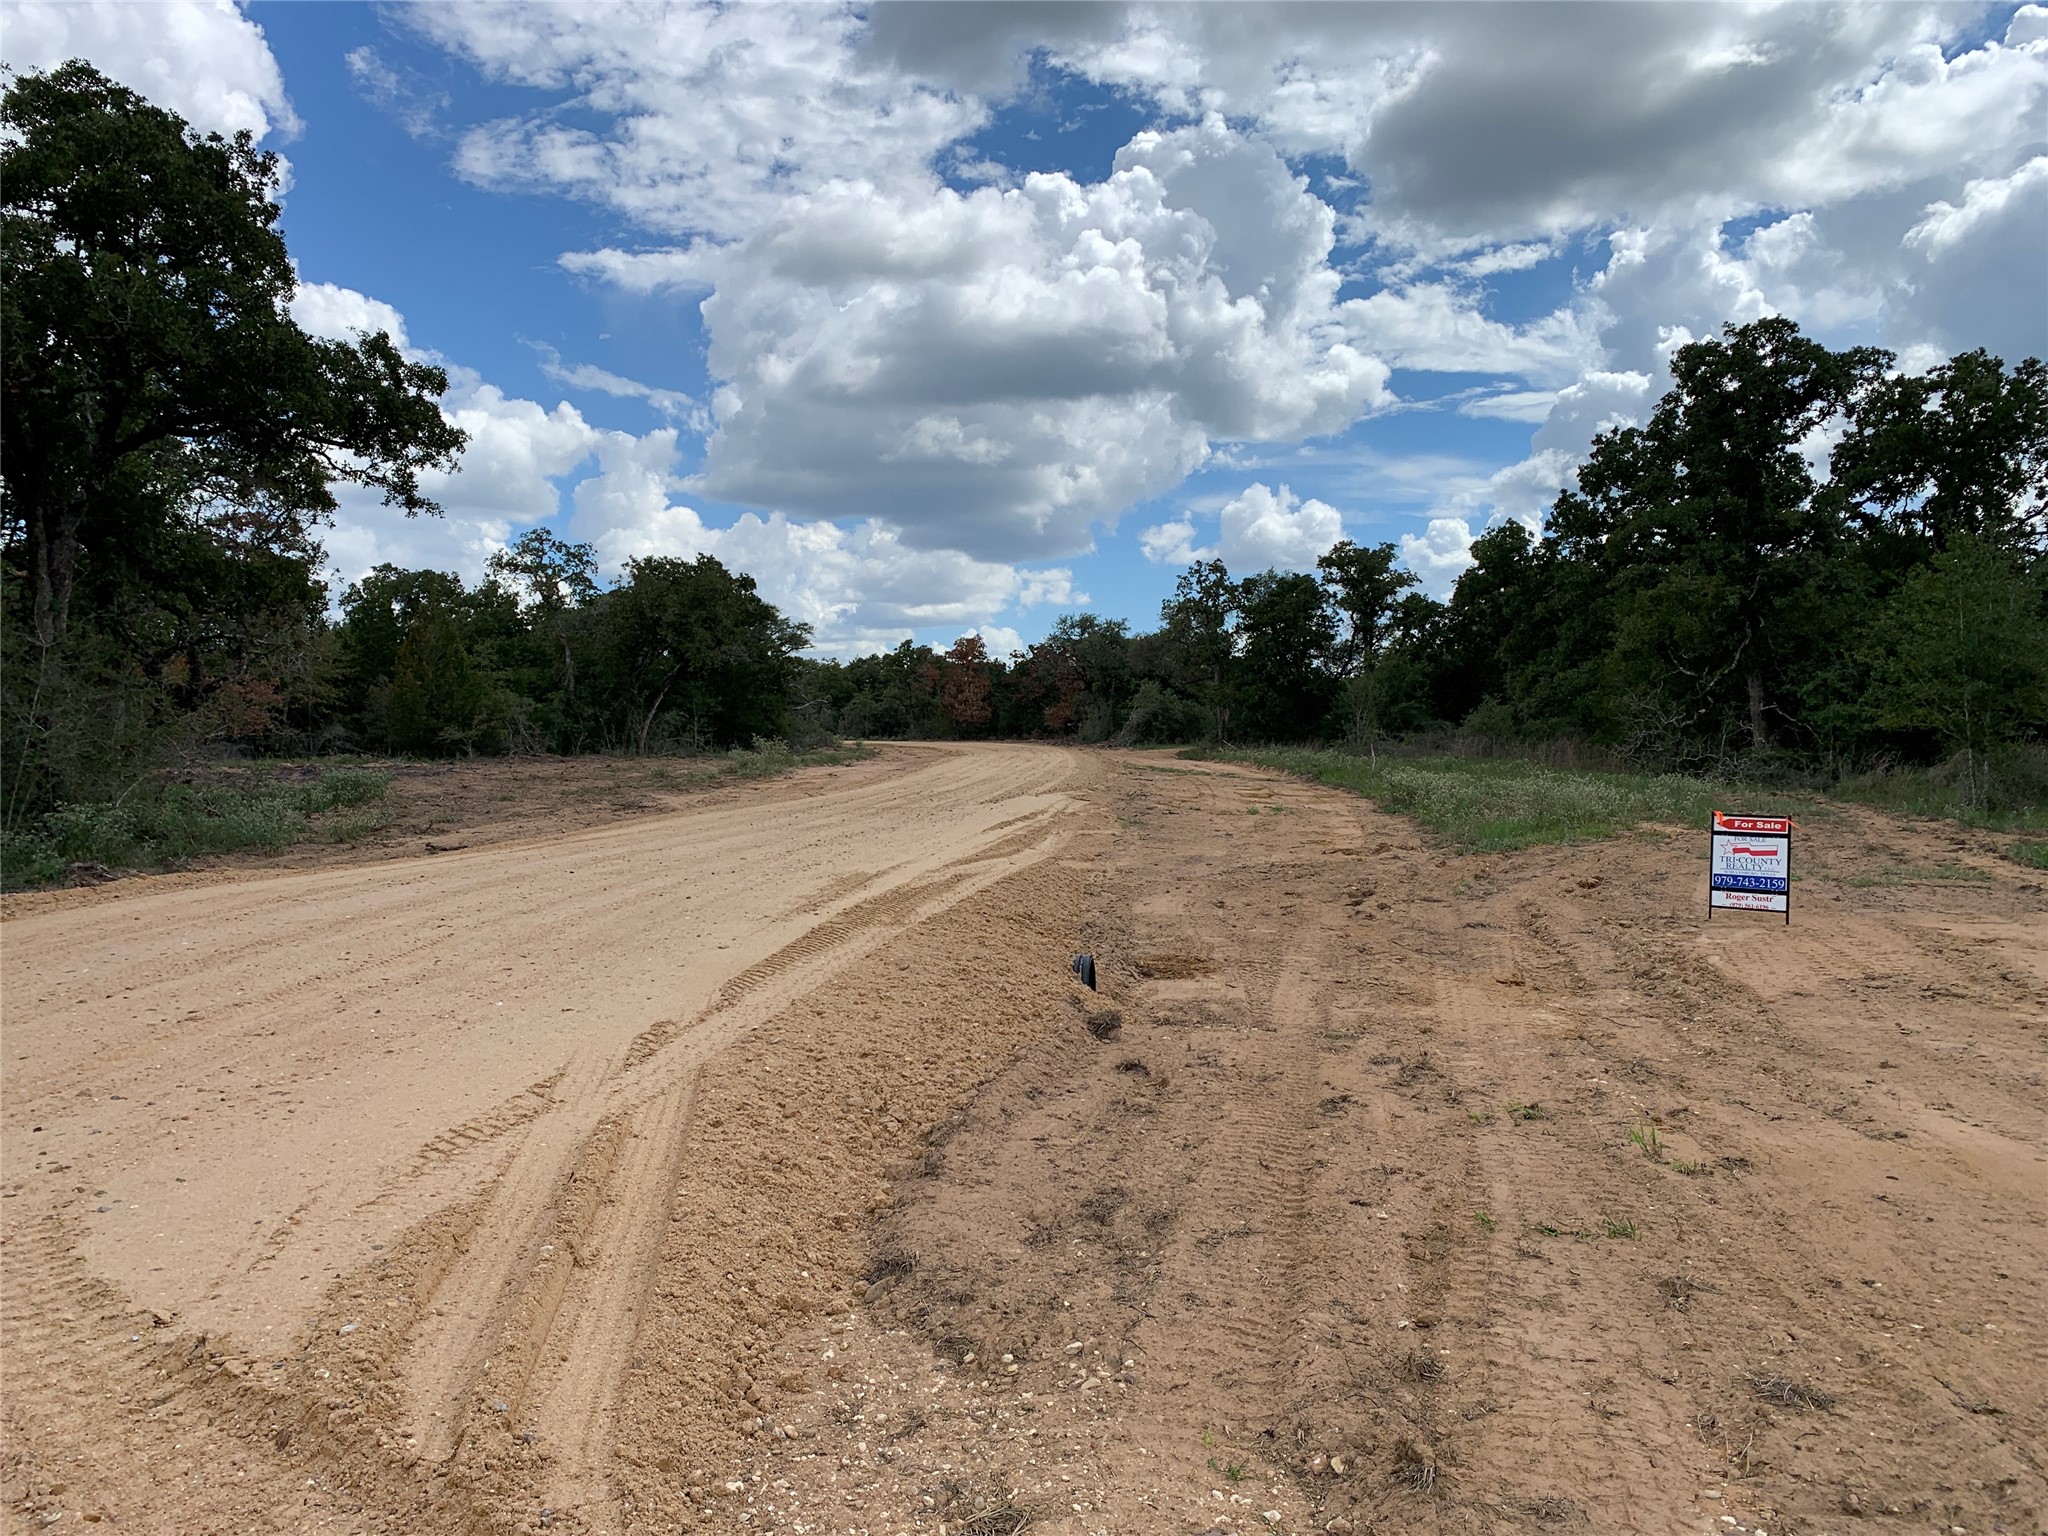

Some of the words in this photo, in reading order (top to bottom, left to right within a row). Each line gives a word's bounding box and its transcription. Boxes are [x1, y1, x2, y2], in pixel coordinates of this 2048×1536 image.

[1734, 820, 1754, 828] For
[1756, 821, 1782, 829] Sale
[1726, 863, 1764, 871] REALTY
[1714, 876, 1784, 888] 979-743-2159
[1726, 893, 1750, 901] Roger
